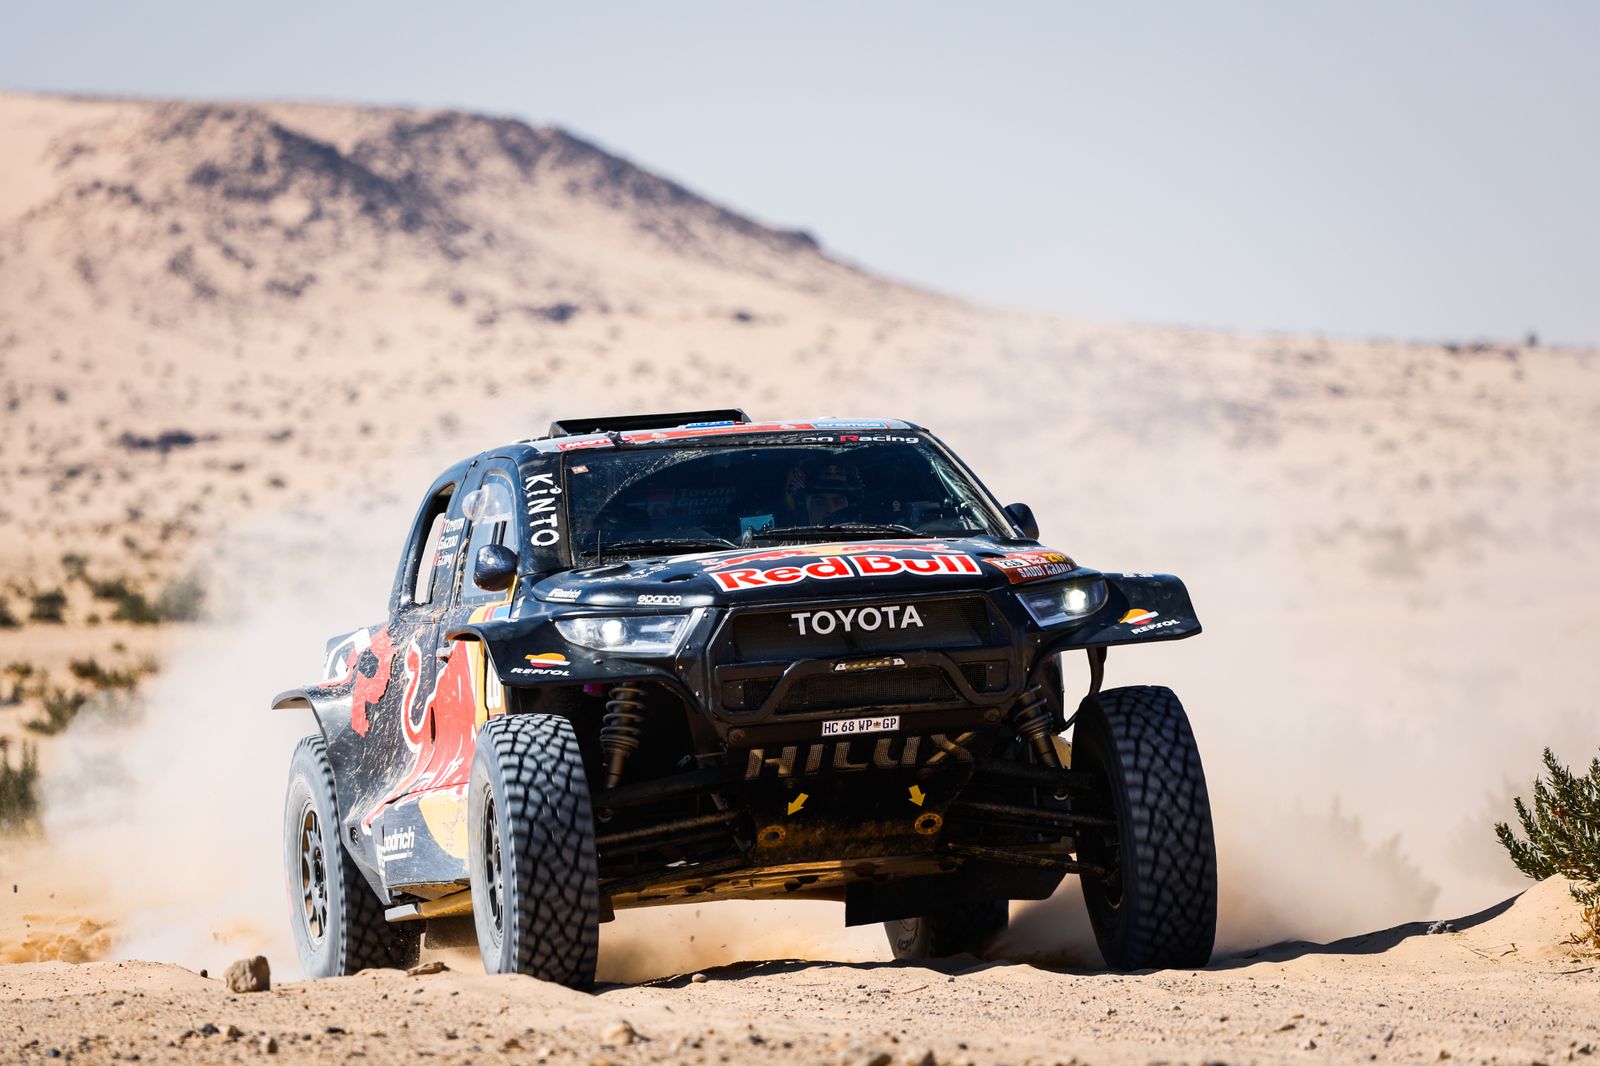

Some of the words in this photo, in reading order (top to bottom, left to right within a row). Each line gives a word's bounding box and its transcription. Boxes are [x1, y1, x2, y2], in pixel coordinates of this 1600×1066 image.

[565, 436, 630, 448] MOTL
[839, 434, 919, 444] Racing
[712, 556, 853, 592] Red
[851, 554, 981, 577] Bull
[1017, 565, 1046, 578] SAUDI
[637, 594, 682, 606] sparco
[791, 605, 924, 636] TOYOTA
[1130, 619, 1180, 635] REPSOL
[510, 667, 570, 677] REPSOL
[823, 722, 838, 734] HC
[841, 720, 855, 732] 68
[858, 719, 873, 732] WP
[882, 717, 897, 729] GP
[744, 732, 975, 780] HILUX
